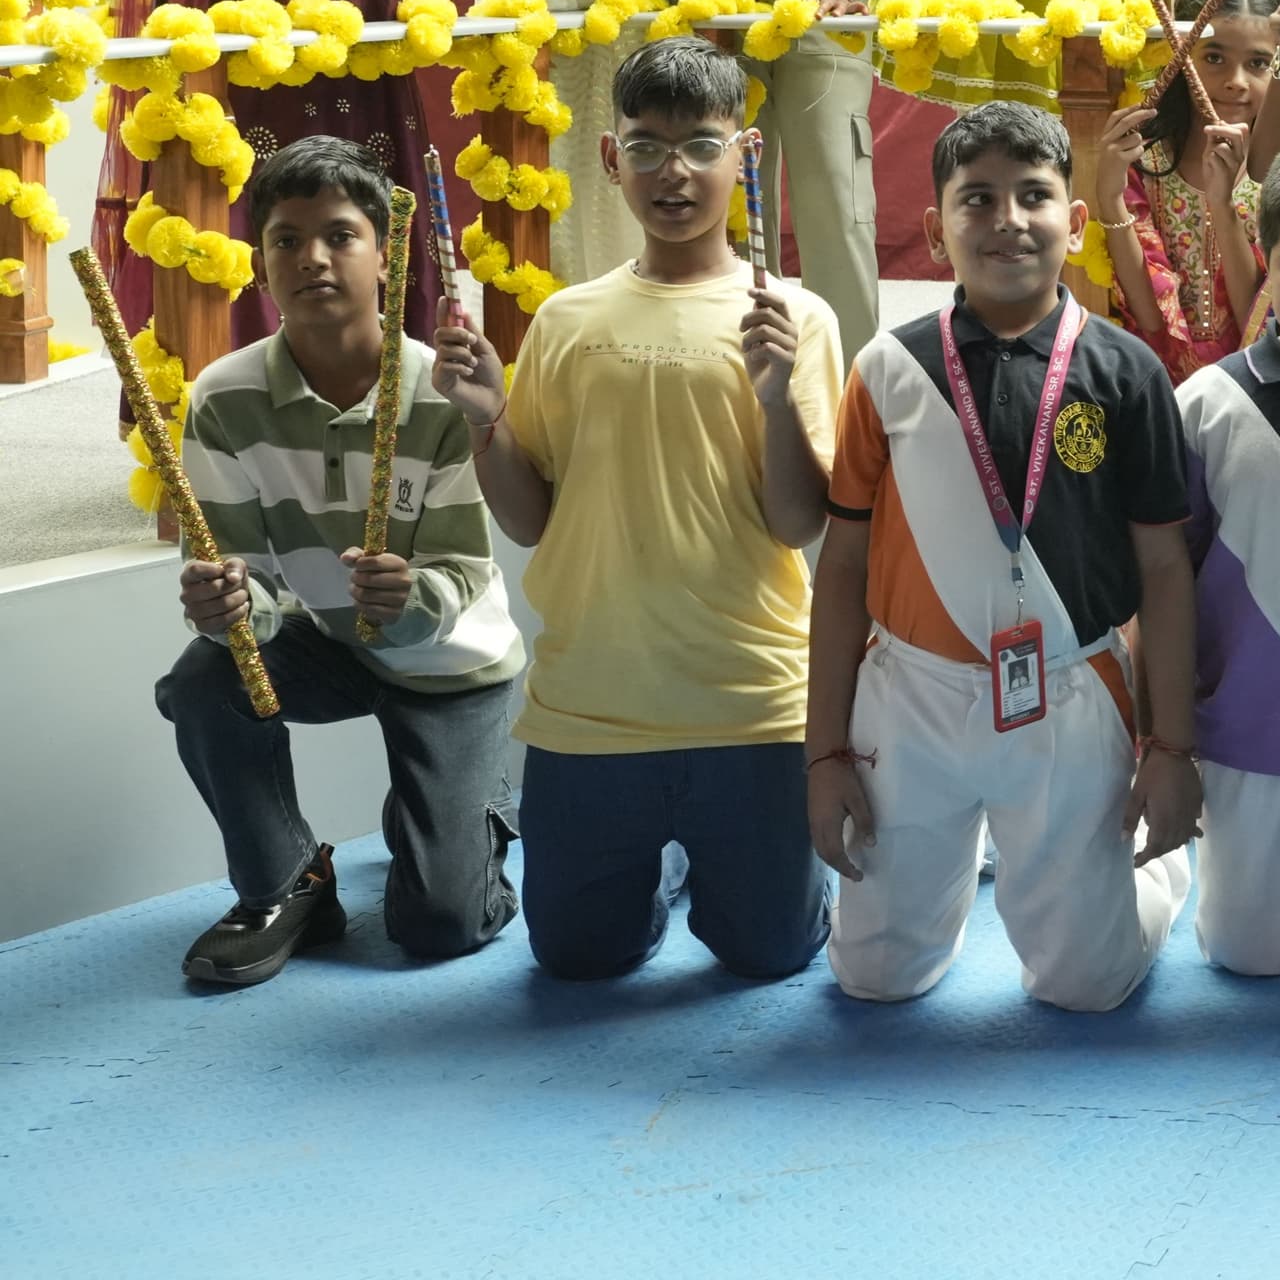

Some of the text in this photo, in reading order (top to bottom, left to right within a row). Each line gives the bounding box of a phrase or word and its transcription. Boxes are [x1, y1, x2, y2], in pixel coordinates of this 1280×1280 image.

[962, 395, 993, 474] VIVEKANAND
[1032, 392, 1055, 473] VIVEKANAND
[1048, 374, 1060, 392] SR.
